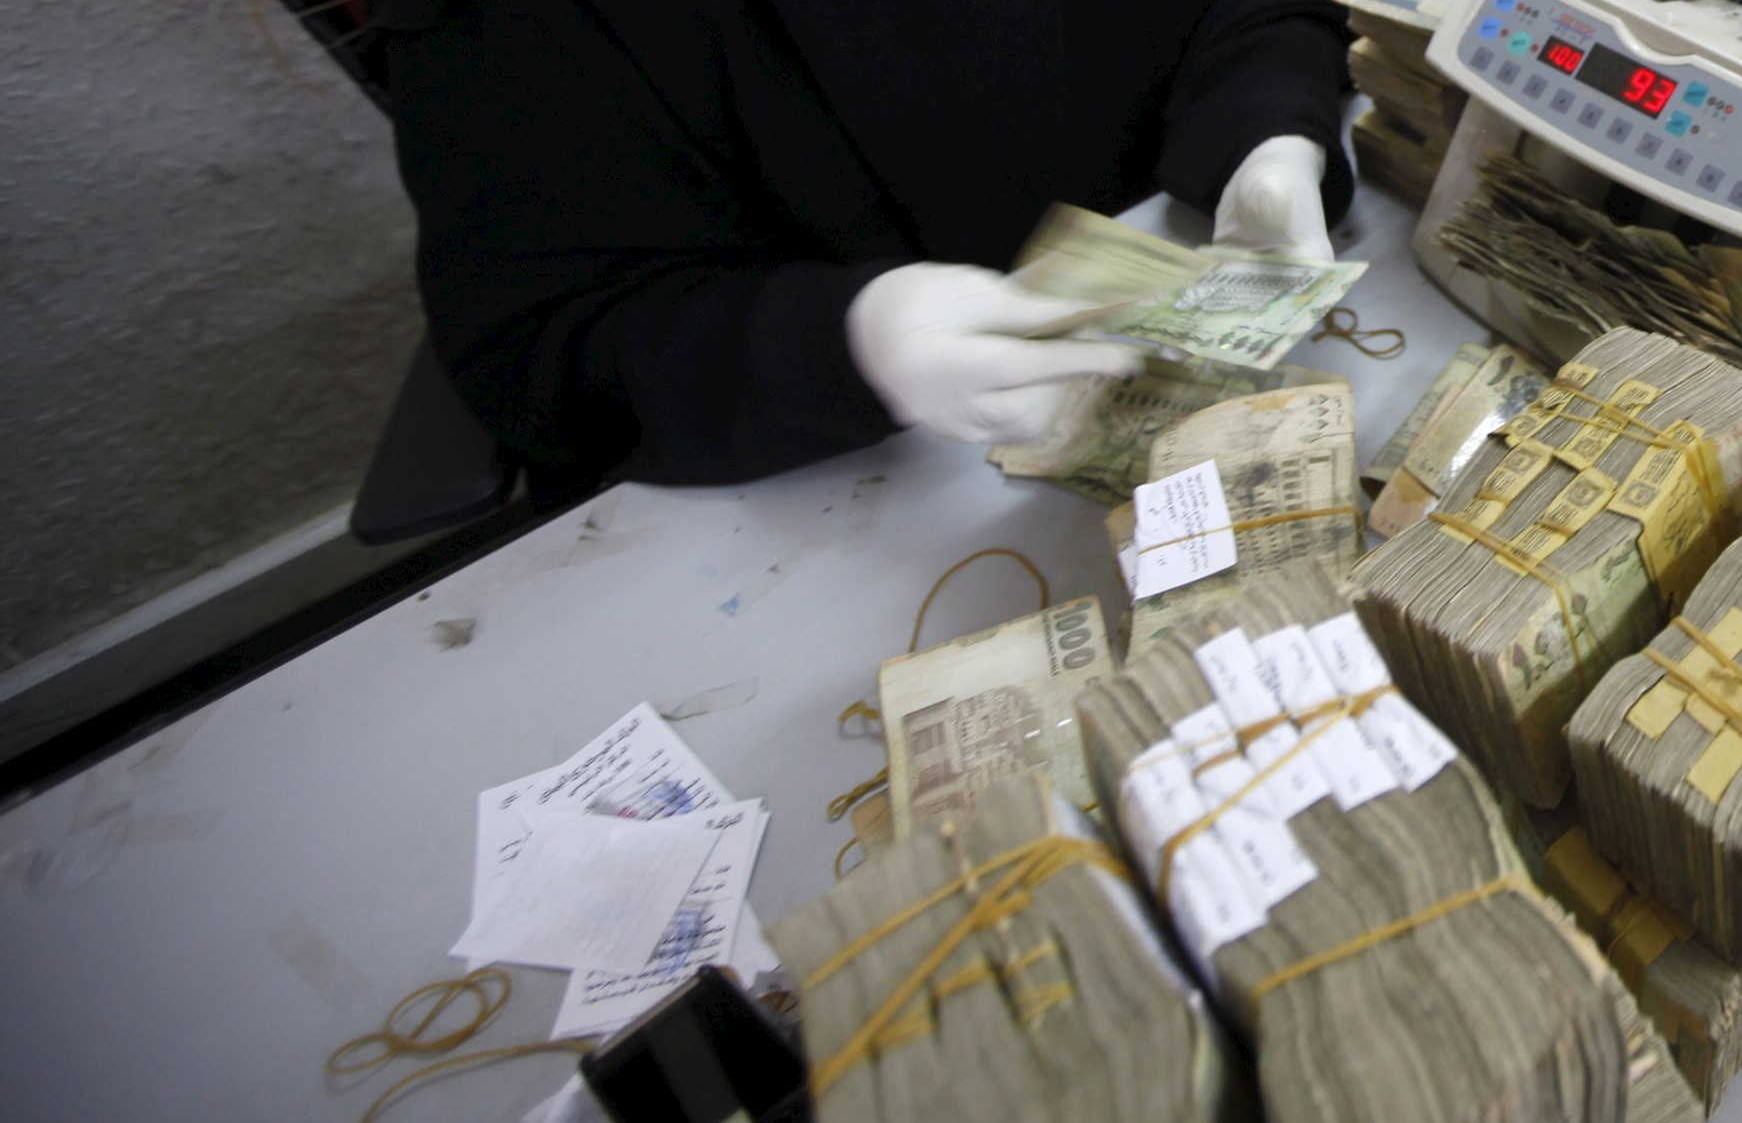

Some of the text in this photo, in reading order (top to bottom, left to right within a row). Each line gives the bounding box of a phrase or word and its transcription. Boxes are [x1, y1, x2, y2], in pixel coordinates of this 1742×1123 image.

[1546, 44, 1583, 73] 100
[1622, 67, 1677, 113] 93
[1053, 601, 1096, 670] 1000
